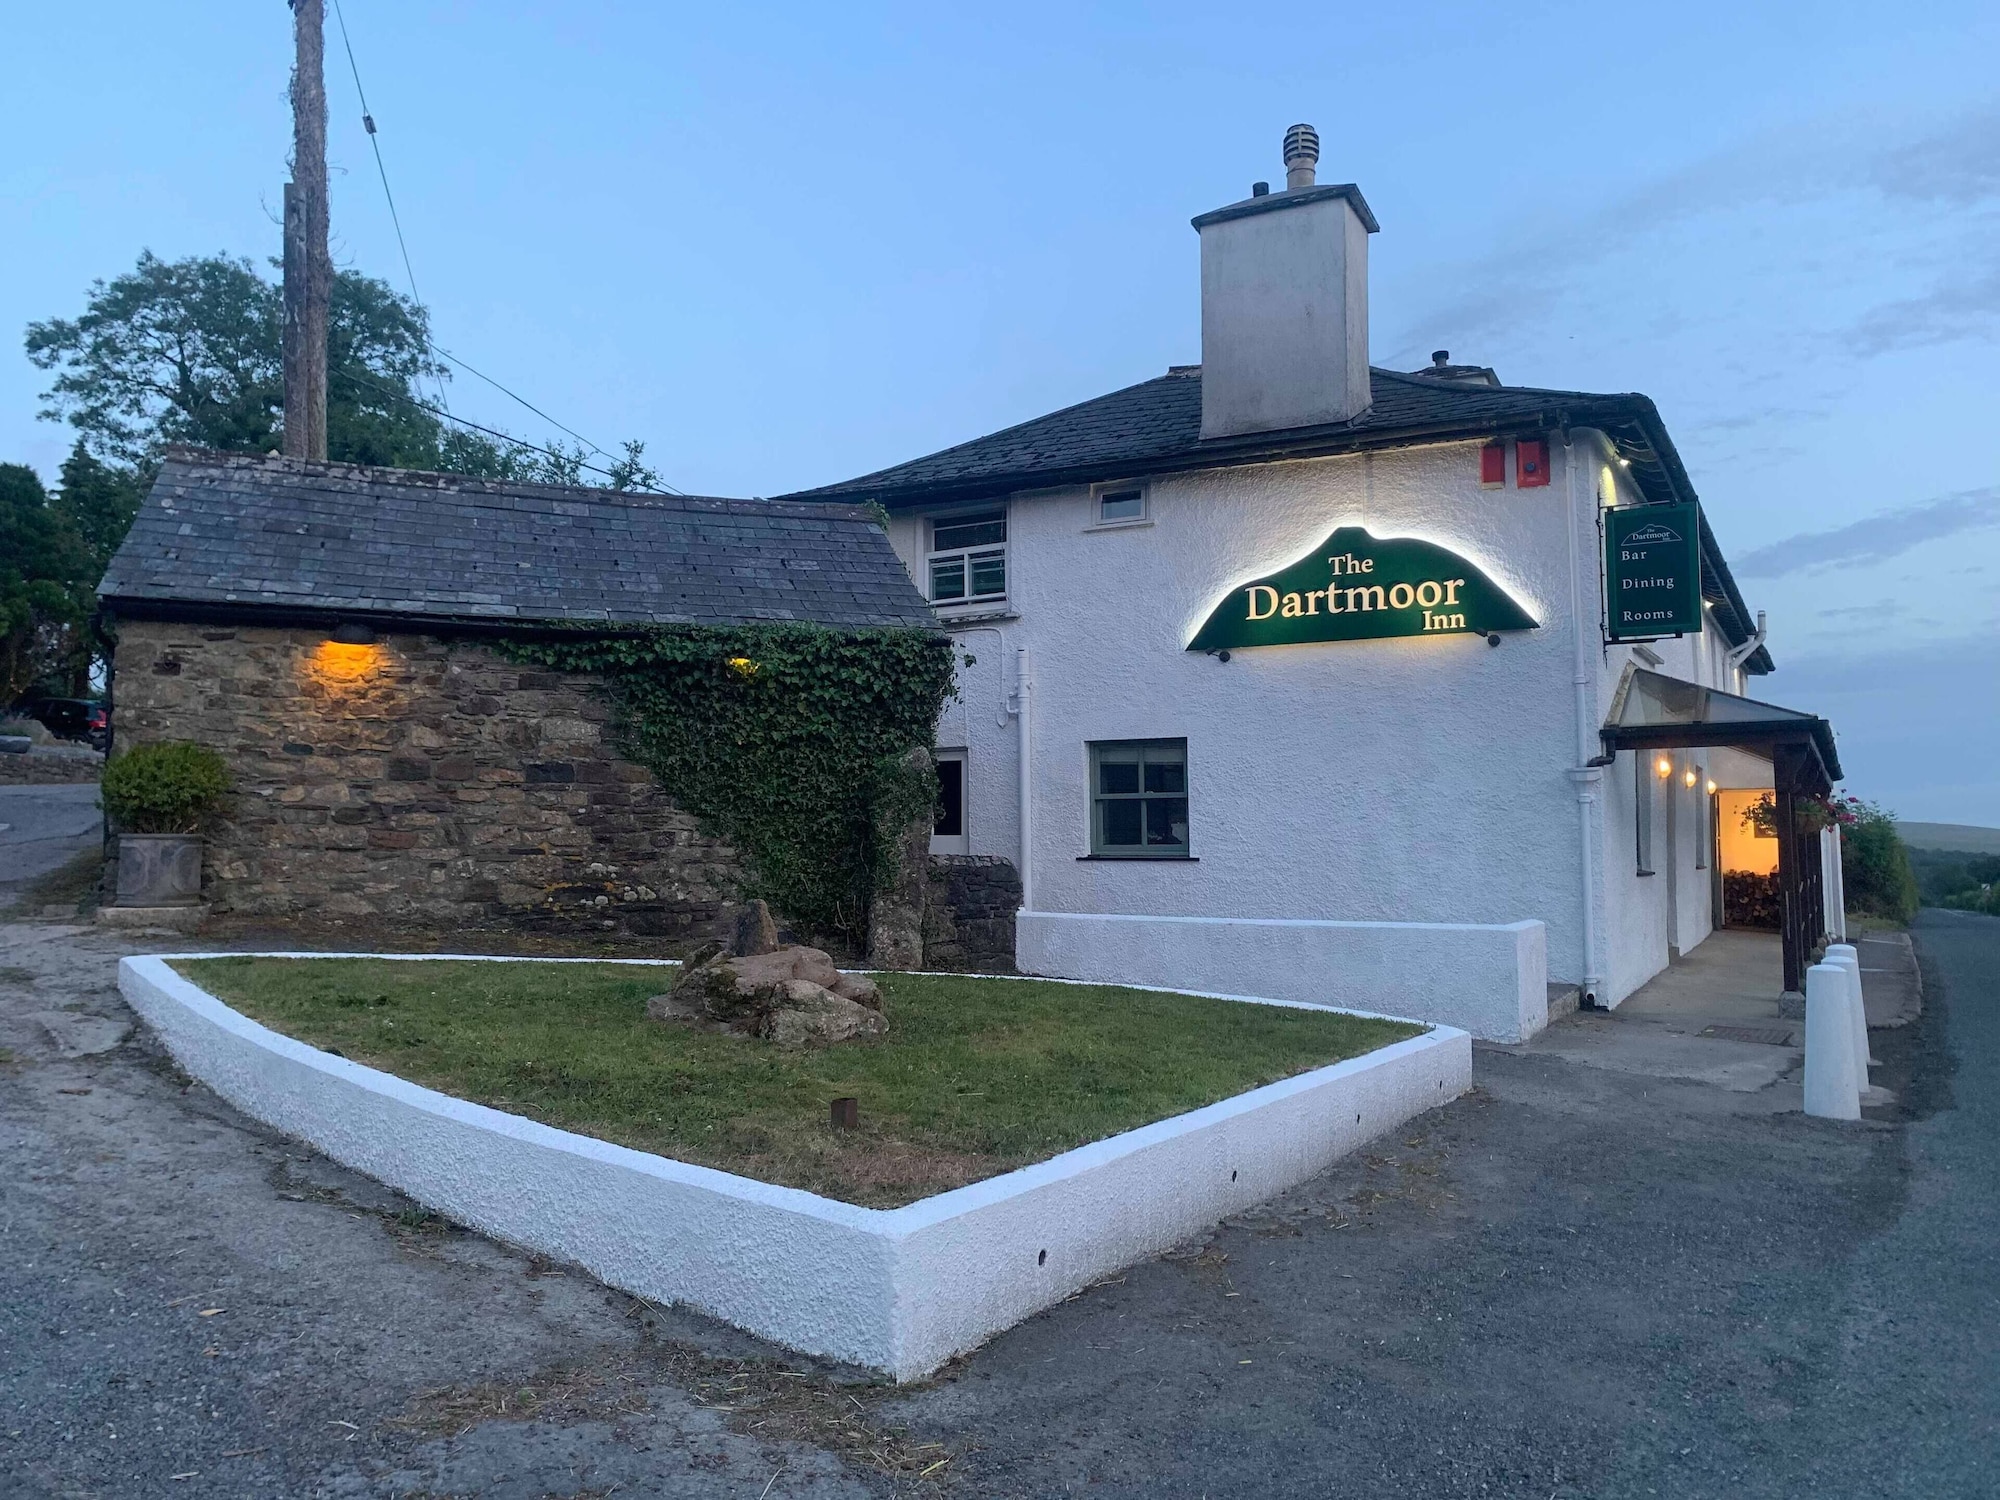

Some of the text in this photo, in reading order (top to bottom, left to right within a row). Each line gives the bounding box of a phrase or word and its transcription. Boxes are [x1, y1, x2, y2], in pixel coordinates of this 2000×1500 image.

[1632, 531, 1670, 541] Dartmoor
[1621, 550, 1647, 561] Bar
[1328, 553, 1373, 575] The
[1622, 577, 1674, 590] Dining
[1244, 578, 1466, 621] Dartmoor
[1422, 609, 1467, 631] Inn
[1623, 610, 1673, 622] Rooms
